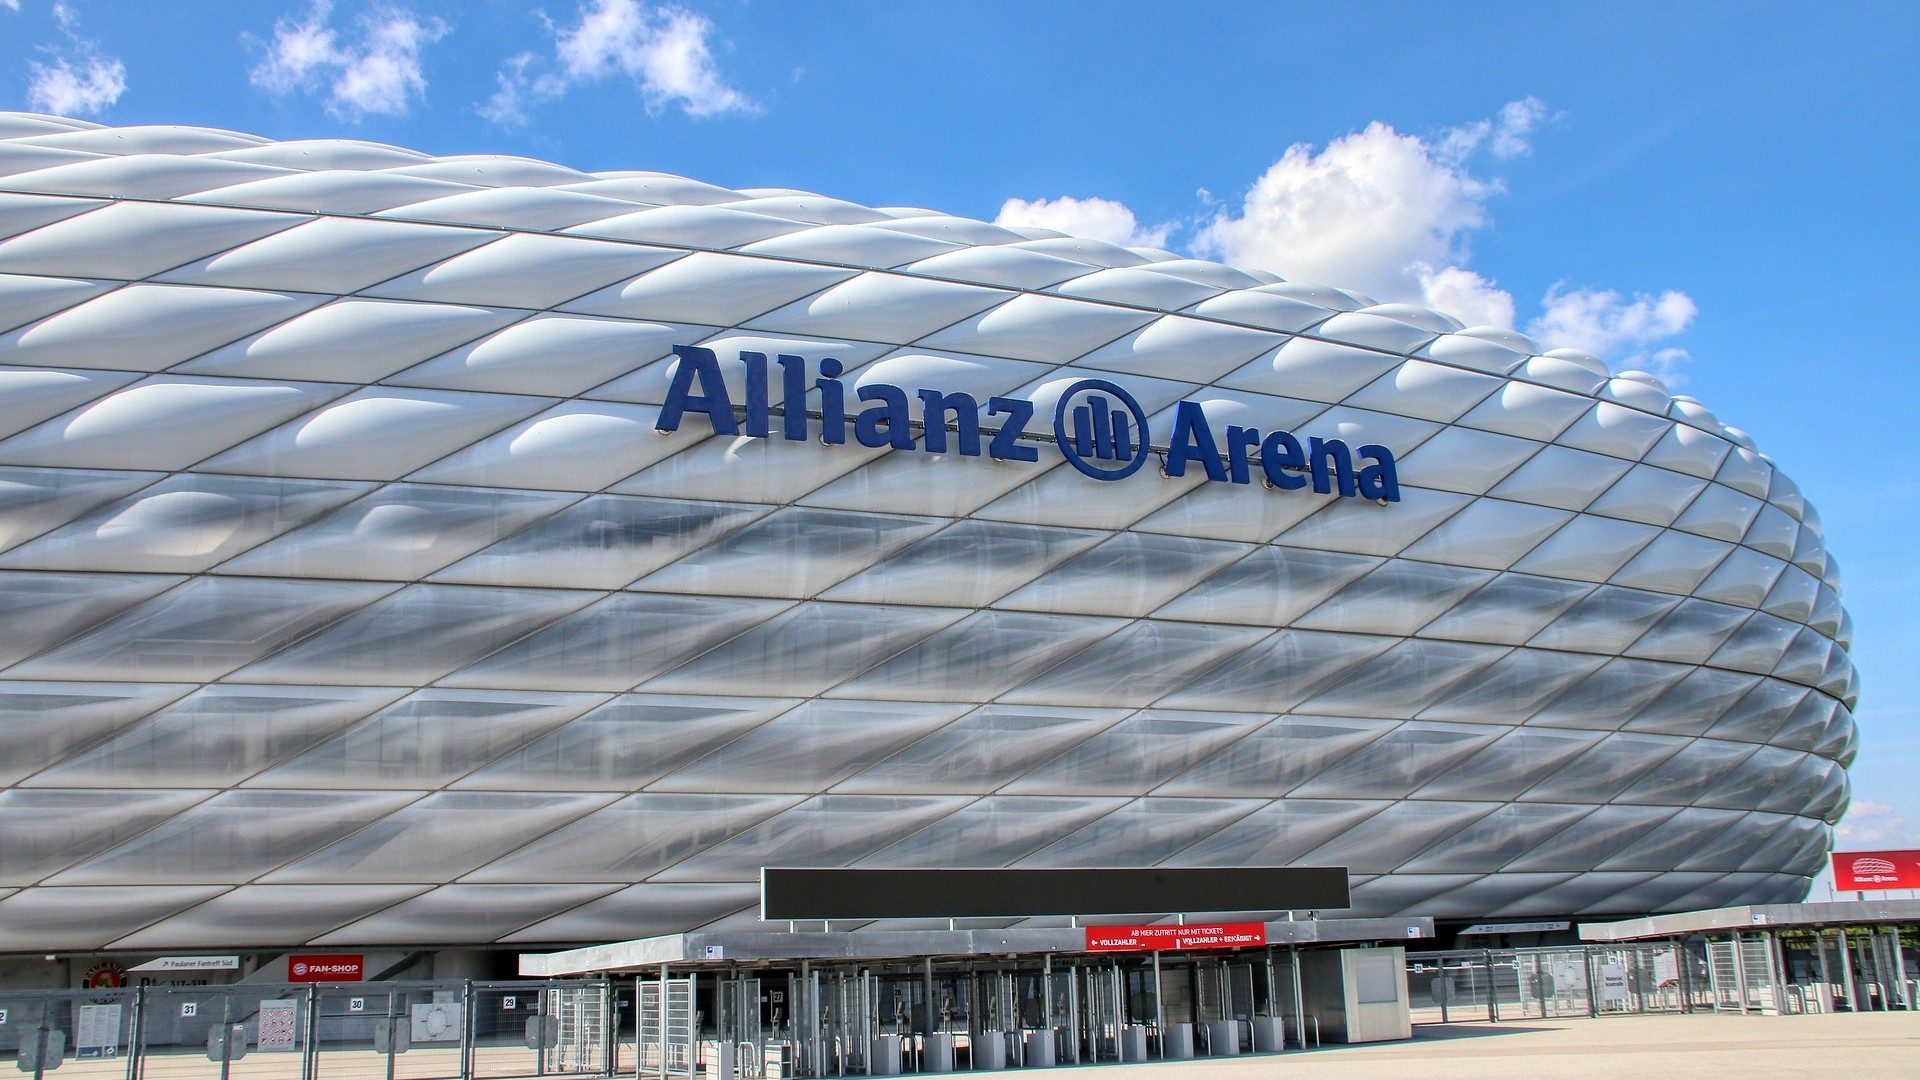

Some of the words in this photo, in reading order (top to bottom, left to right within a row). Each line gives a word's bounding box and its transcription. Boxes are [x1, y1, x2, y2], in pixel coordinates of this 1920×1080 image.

[655, 344, 1038, 462] Allianz
[1166, 401, 1400, 503] Arena
[774, 993, 782, 1001] 27
[352, 1001, 361, 1009] 30
[505, 999, 513, 1007] 29
[184, 1005, 194, 1014] 31
